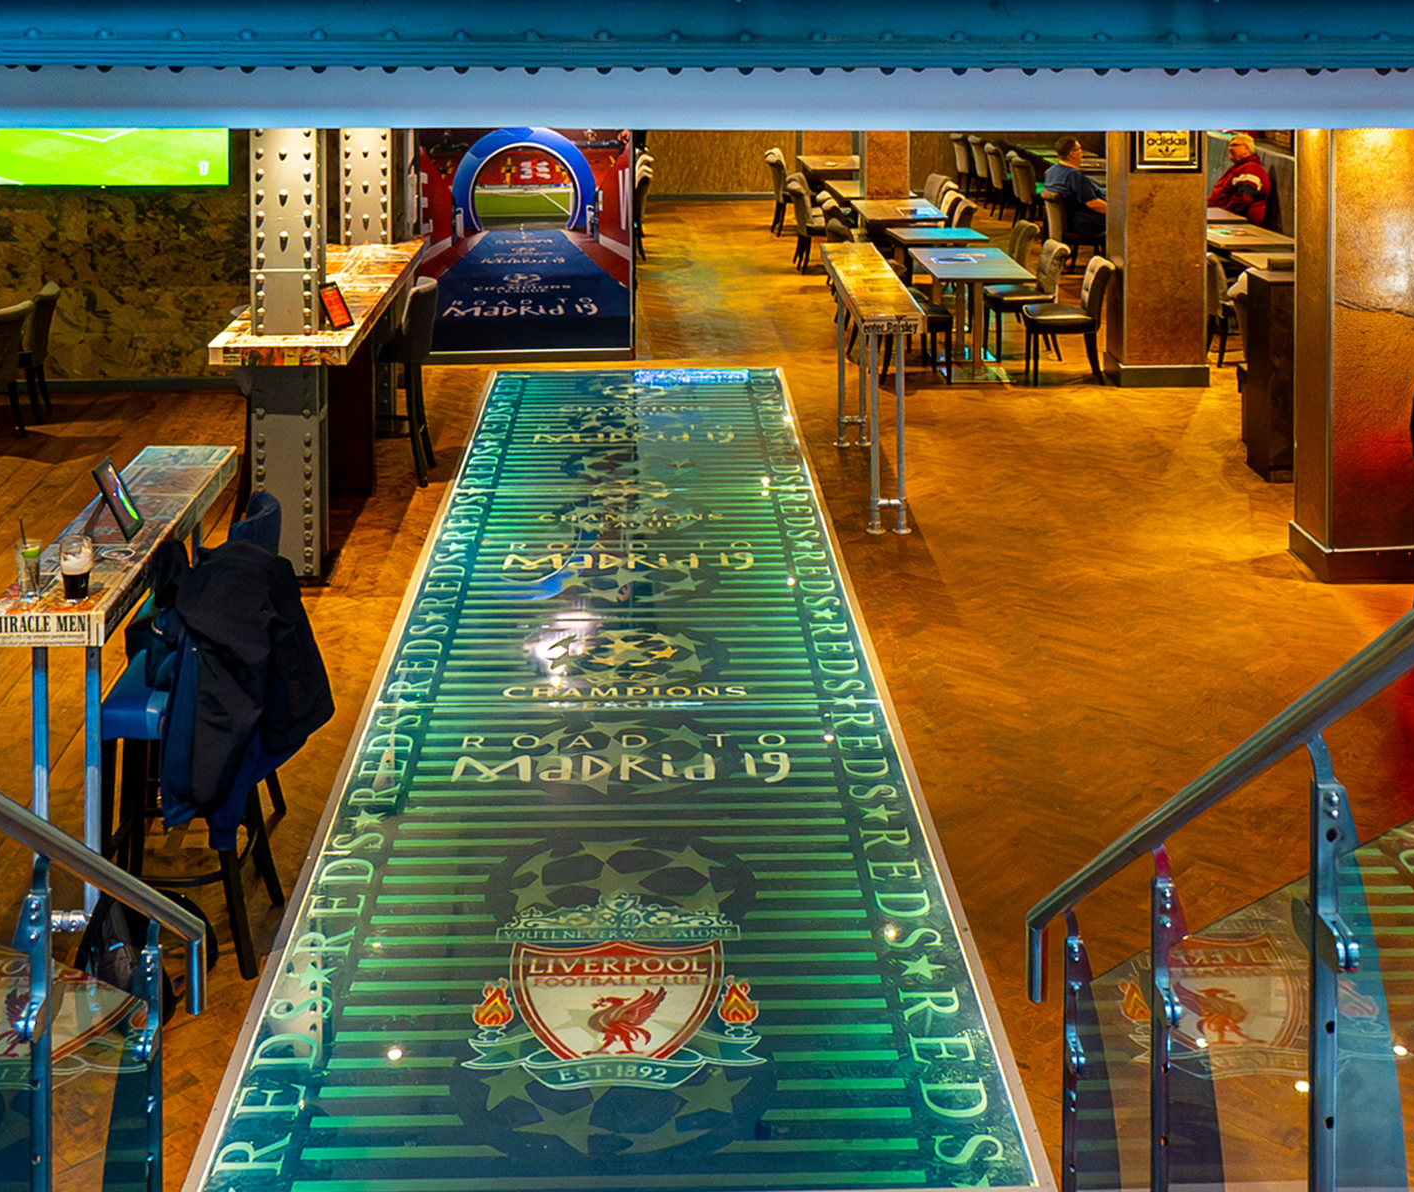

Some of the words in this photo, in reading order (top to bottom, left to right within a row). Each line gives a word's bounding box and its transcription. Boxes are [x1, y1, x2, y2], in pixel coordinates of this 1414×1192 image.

[1147, 136, 1187, 146] adidas
[452, 298, 533, 306] ROAD
[477, 407, 515, 441] REDS
[461, 446, 503, 486] REDS
[441, 495, 488, 542] REDS
[539, 512, 725, 522] CHAMIONS
[777, 492, 821, 538] REDS
[419, 552, 468, 609] REDS
[720, 551, 755, 570] 19
[791, 550, 841, 607] REDS
[56, 614, 87, 633] MEN
[387, 623, 450, 696] REDS
[808, 621, 867, 693] REDS
[502, 685, 748, 699] CHAMPIONS
[348, 714, 422, 806] REDS
[461, 733, 649, 749] ROAD
[706, 733, 787, 748] TO
[830, 710, 898, 801] REDS
[743, 751, 791, 783] 19
[291, 832, 385, 957] REDS
[858, 826, 945, 948] REDS
[528, 956, 707, 974] LIVERPOOL
[532, 975, 639, 987] FOOTBALL
[646, 975, 700, 986] CLUB
[211, 995, 333, 1177] REDS
[897, 986, 1007, 1166] REDS
